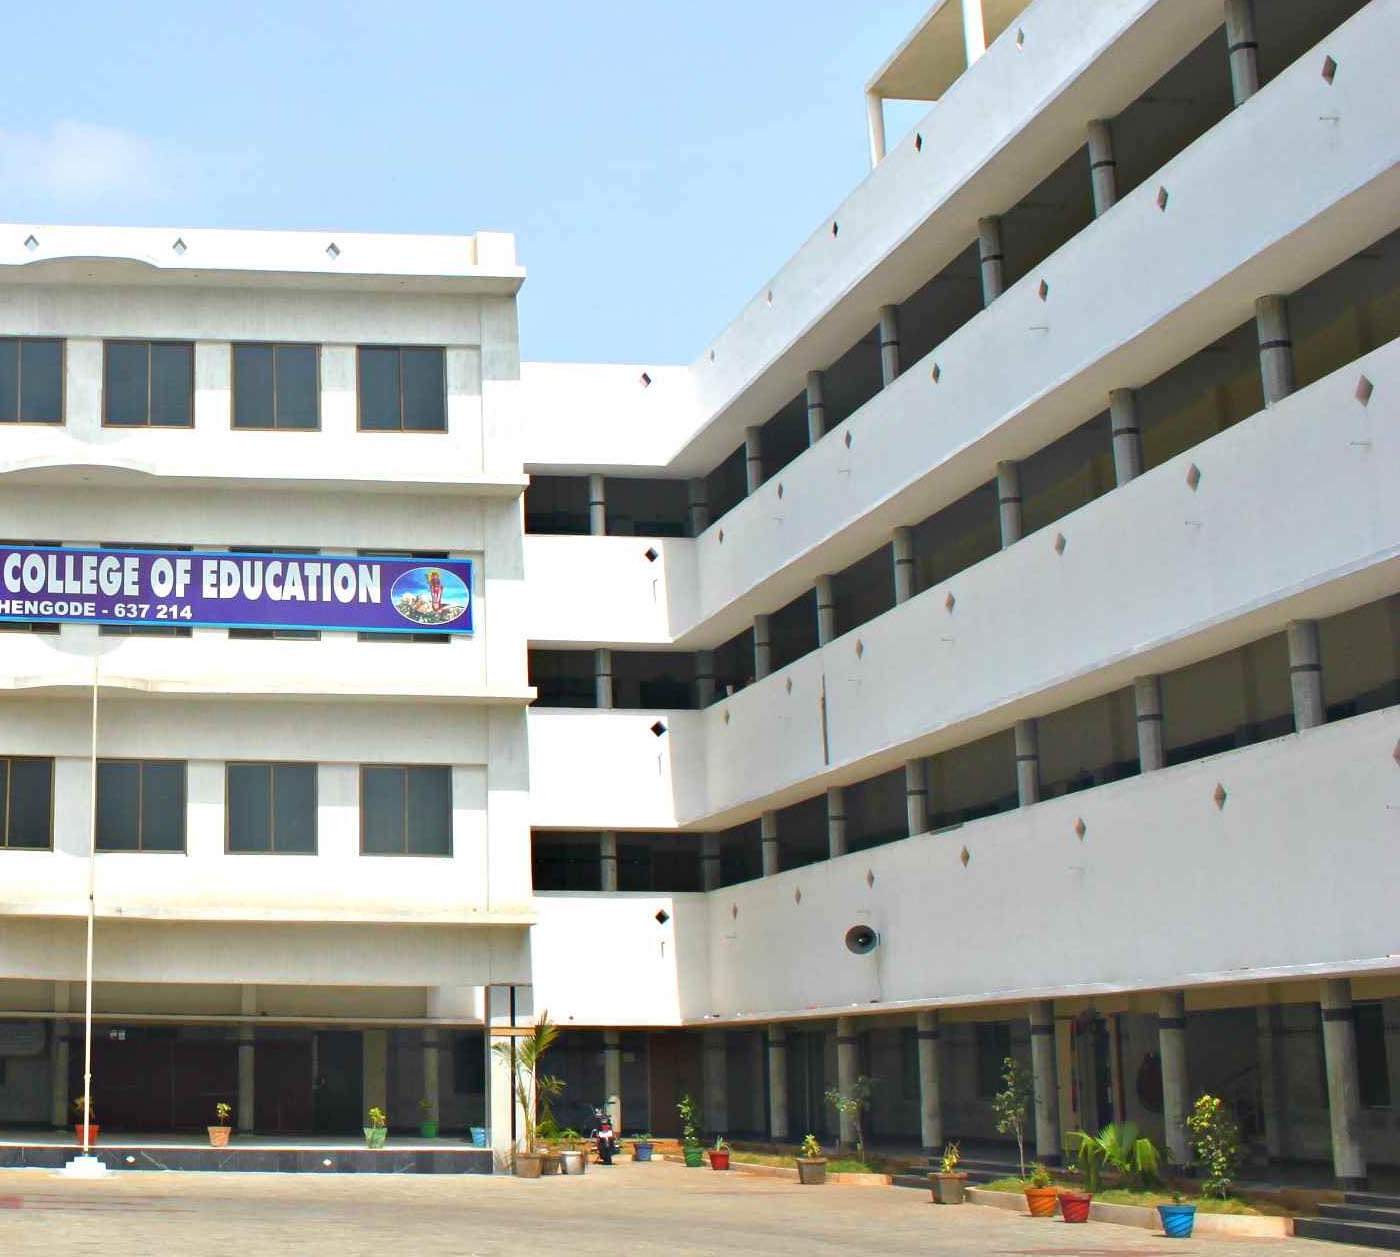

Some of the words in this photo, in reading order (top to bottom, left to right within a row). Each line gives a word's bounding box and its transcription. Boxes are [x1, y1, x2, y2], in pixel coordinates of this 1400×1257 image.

[3, 552, 140, 597] COLLEGE
[150, 557, 192, 598] OF
[202, 559, 381, 604] EDUCATION
[114, 603, 151, 619] 637
[155, 604, 193, 620] 214
